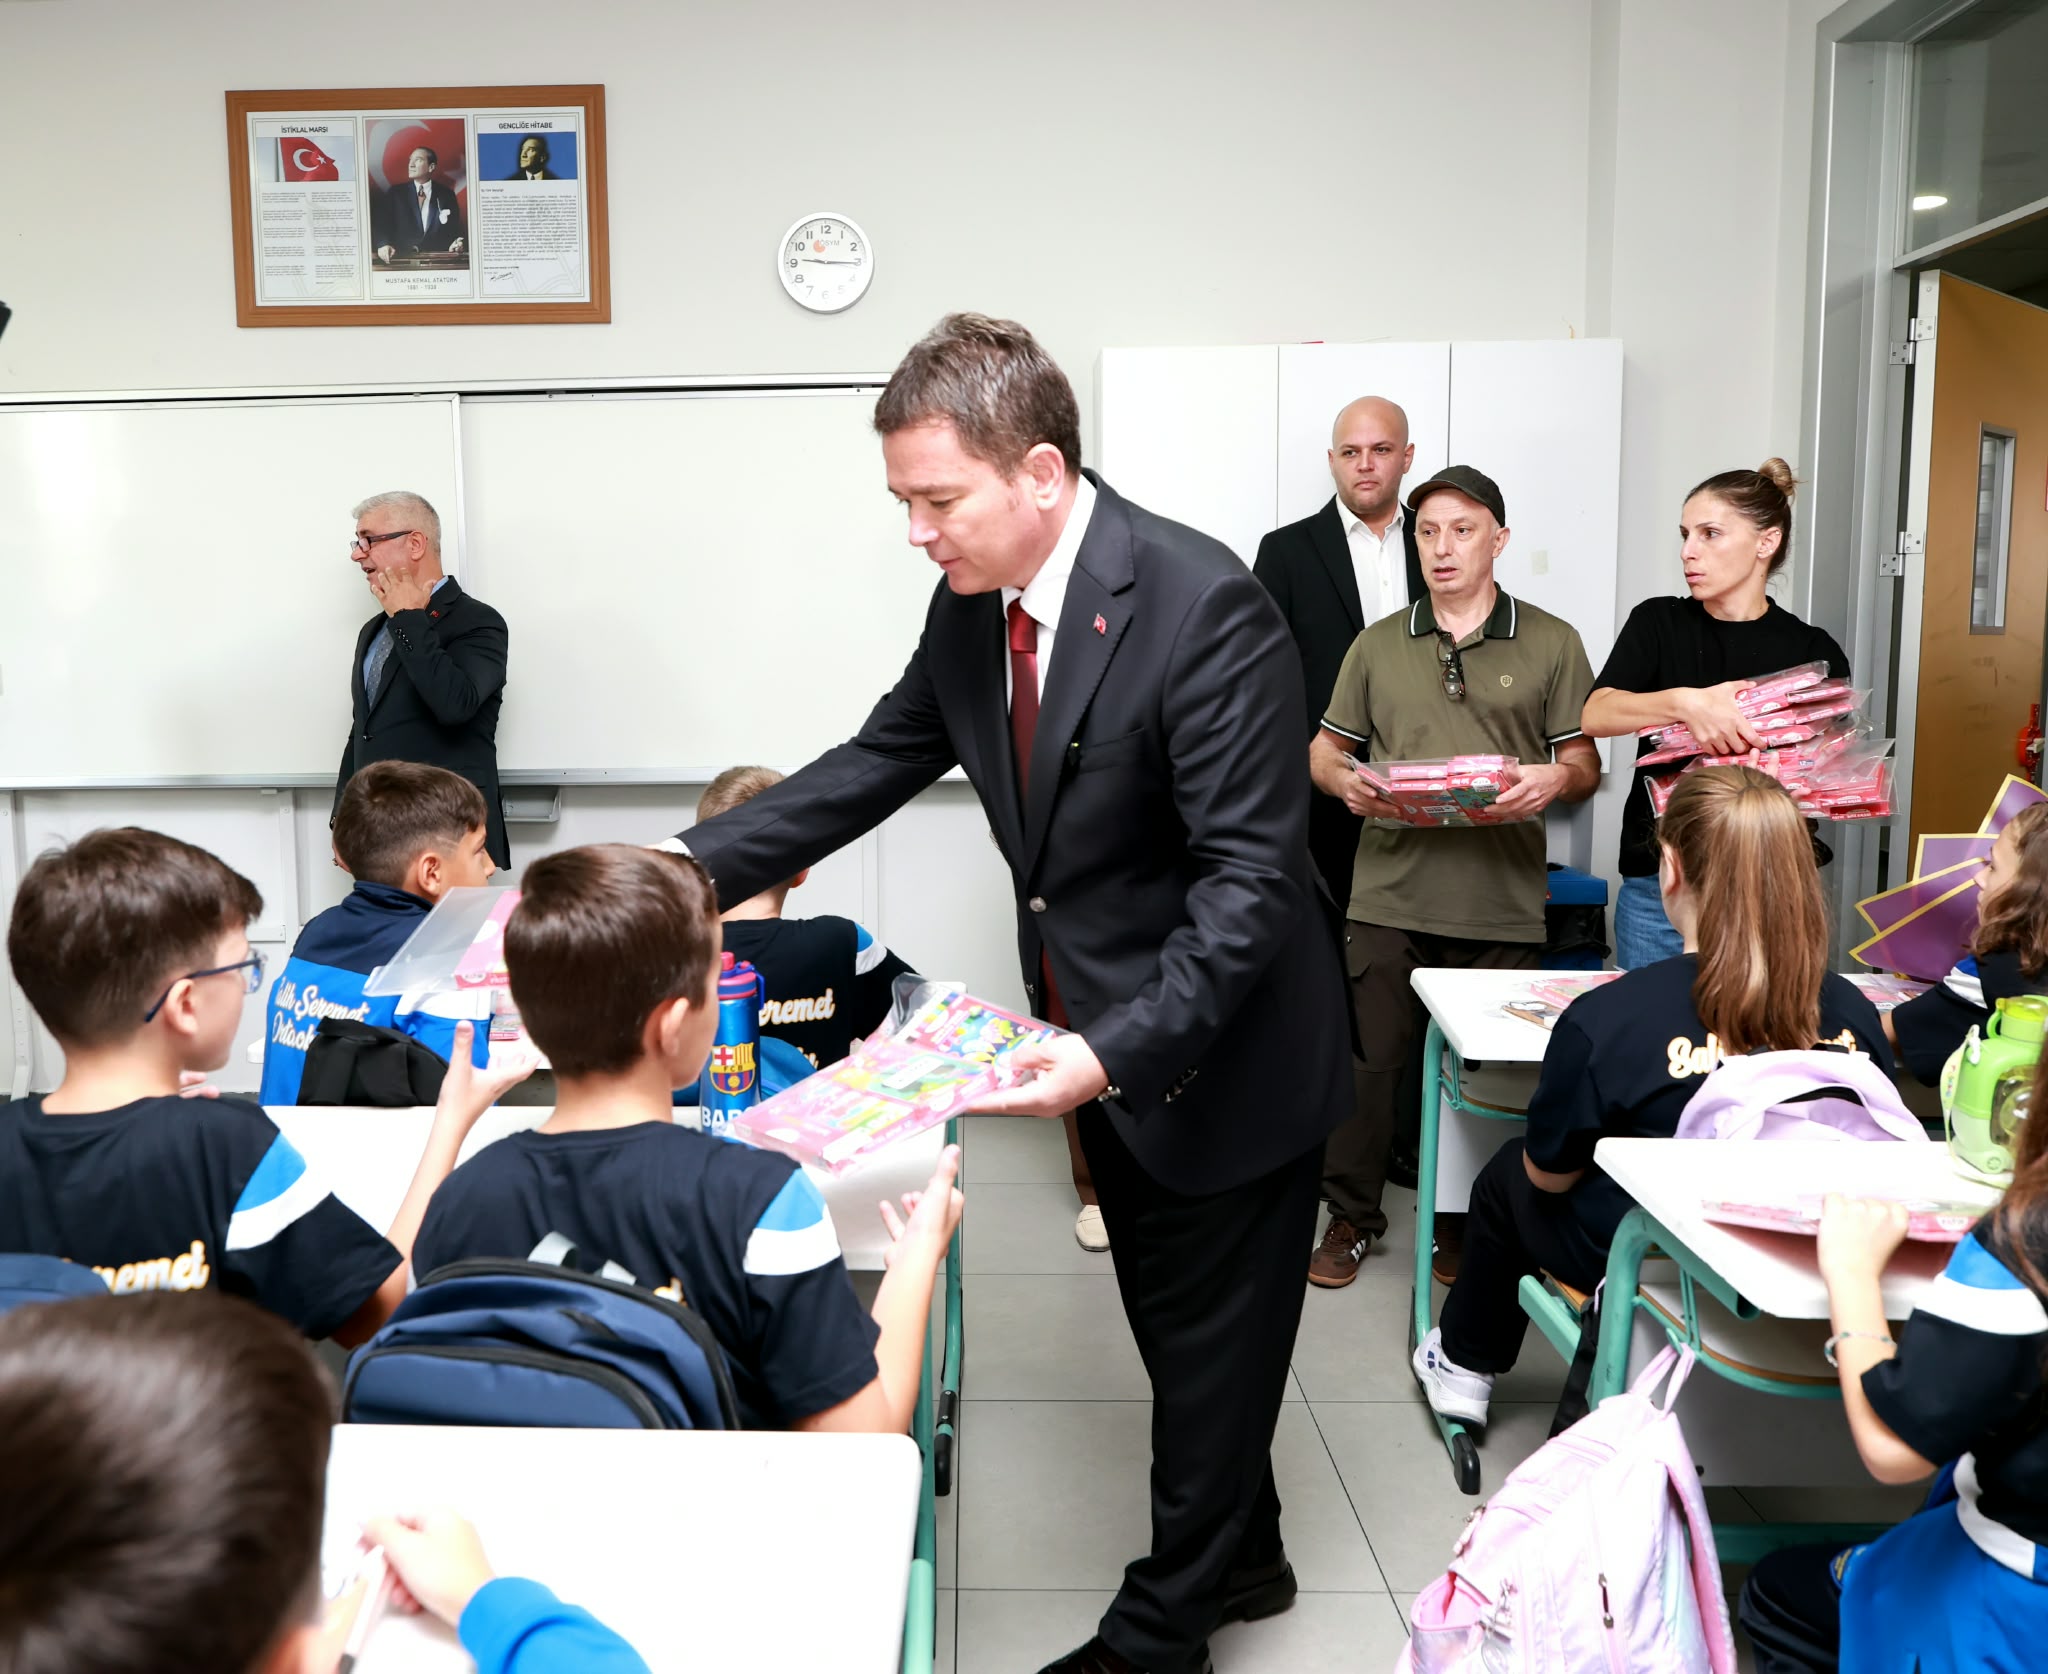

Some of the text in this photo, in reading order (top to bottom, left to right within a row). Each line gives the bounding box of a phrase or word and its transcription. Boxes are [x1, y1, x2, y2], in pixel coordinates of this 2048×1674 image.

[499, 120, 553, 129] GENÇLİĞE HİTABE
[820, 224, 832, 234] 12
[806, 230, 814, 239] 11
[794, 242, 806, 251] 10
[850, 242, 858, 251] 2
[790, 258, 798, 268] 9
[794, 274, 805, 283] 8
[806, 285, 814, 296] 7
[837, 285, 845, 294] 5
[821, 290, 830, 299] 6
[758, 987, 836, 1027] eremet
